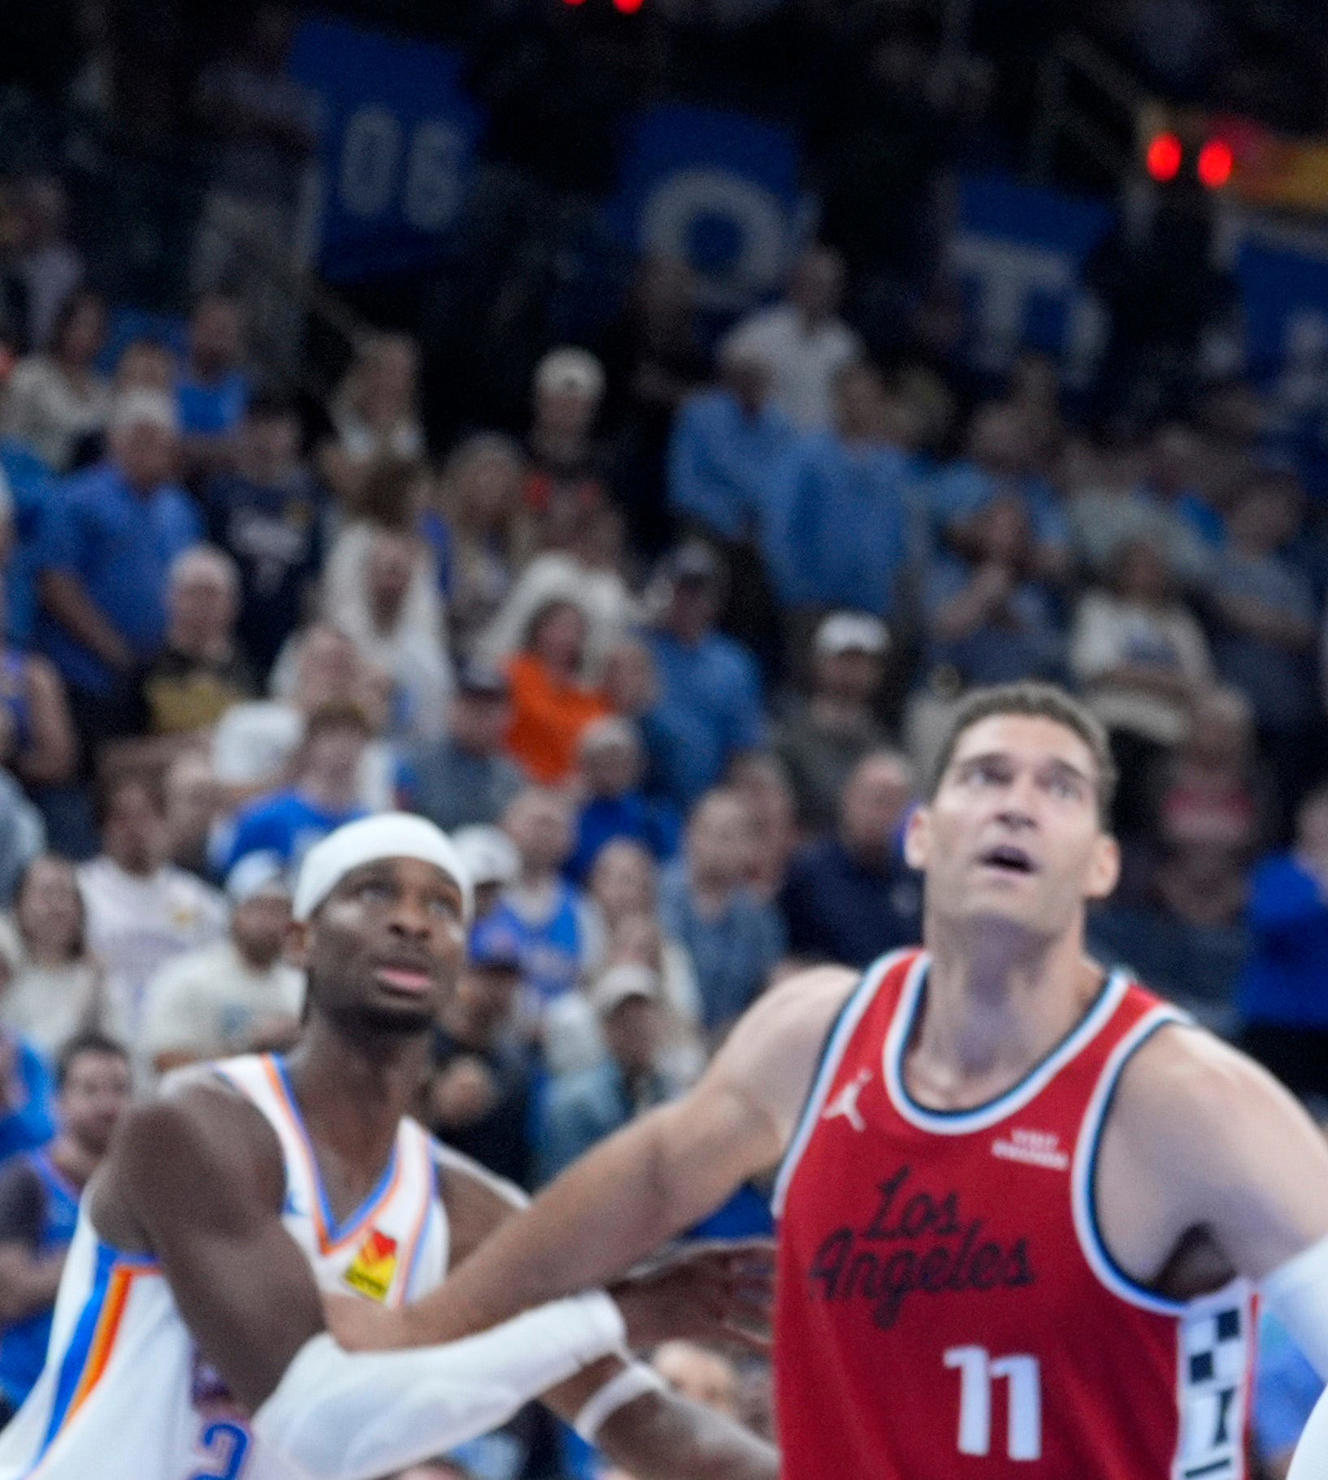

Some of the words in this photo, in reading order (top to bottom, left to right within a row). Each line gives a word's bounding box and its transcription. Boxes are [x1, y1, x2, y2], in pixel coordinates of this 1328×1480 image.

[862, 1164, 960, 1240] Los
[808, 1220, 1033, 1330] Angeles
[944, 1346, 1041, 1461] 11
